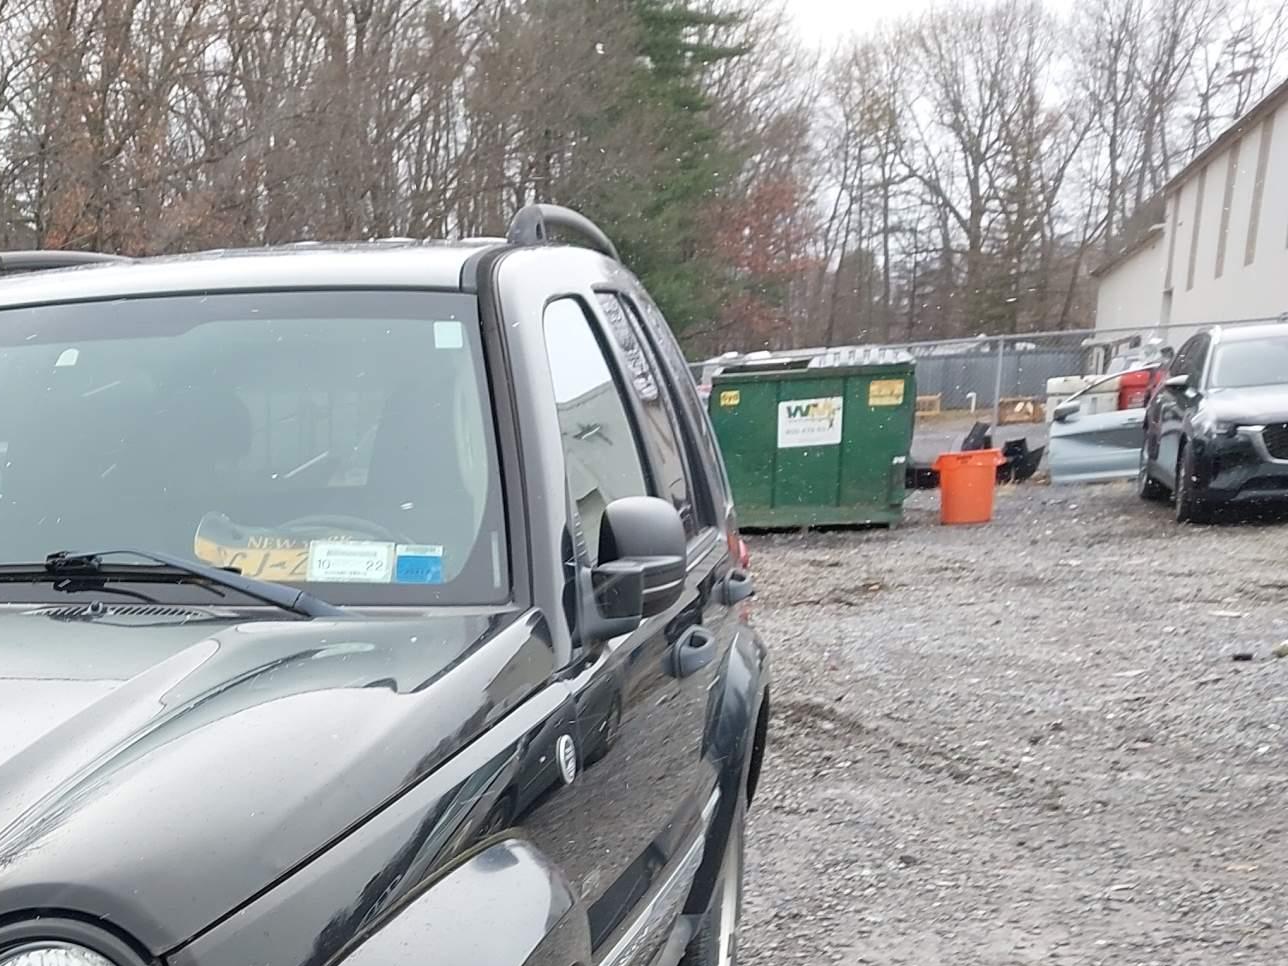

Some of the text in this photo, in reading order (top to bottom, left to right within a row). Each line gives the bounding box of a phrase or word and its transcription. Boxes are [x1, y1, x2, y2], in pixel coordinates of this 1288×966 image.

[247, 535, 297, 549] NEW
[317, 559, 385, 571] 10 22
